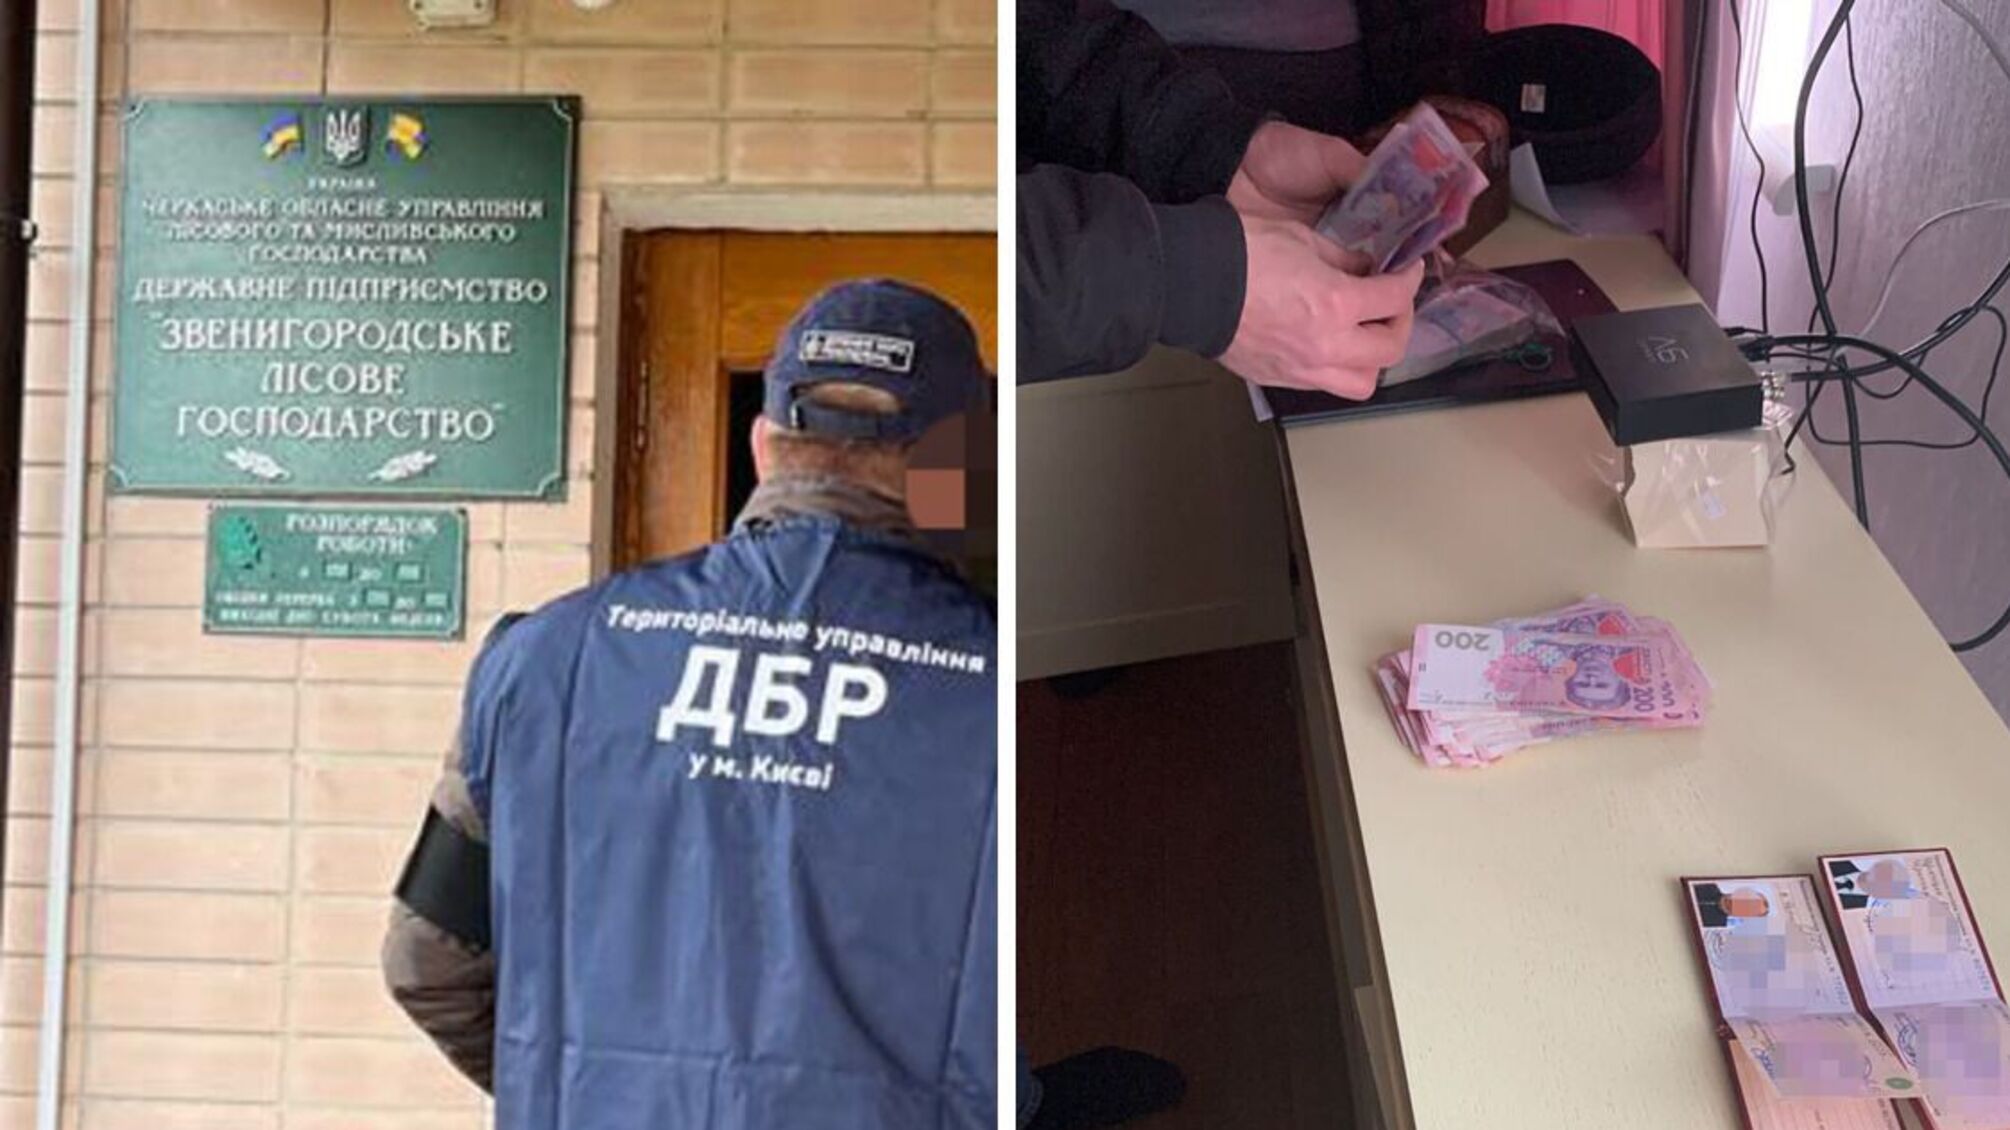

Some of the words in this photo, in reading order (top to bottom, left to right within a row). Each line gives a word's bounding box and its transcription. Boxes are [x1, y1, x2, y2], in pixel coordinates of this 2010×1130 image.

[290, 222, 316, 240] ТА
[134, 276, 294, 302] ДЕРЖАВНЕ
[306, 276, 548, 303] ПІДПРИЄМСТВО
[261, 362, 405, 394] ЛІСОВЕ
[813, 625, 986, 674] управління
[1435, 630, 1491, 652] 200
[655, 645, 888, 747] ДБР
[1633, 686, 1655, 712] 200
[751, 754, 834, 791] Києві
